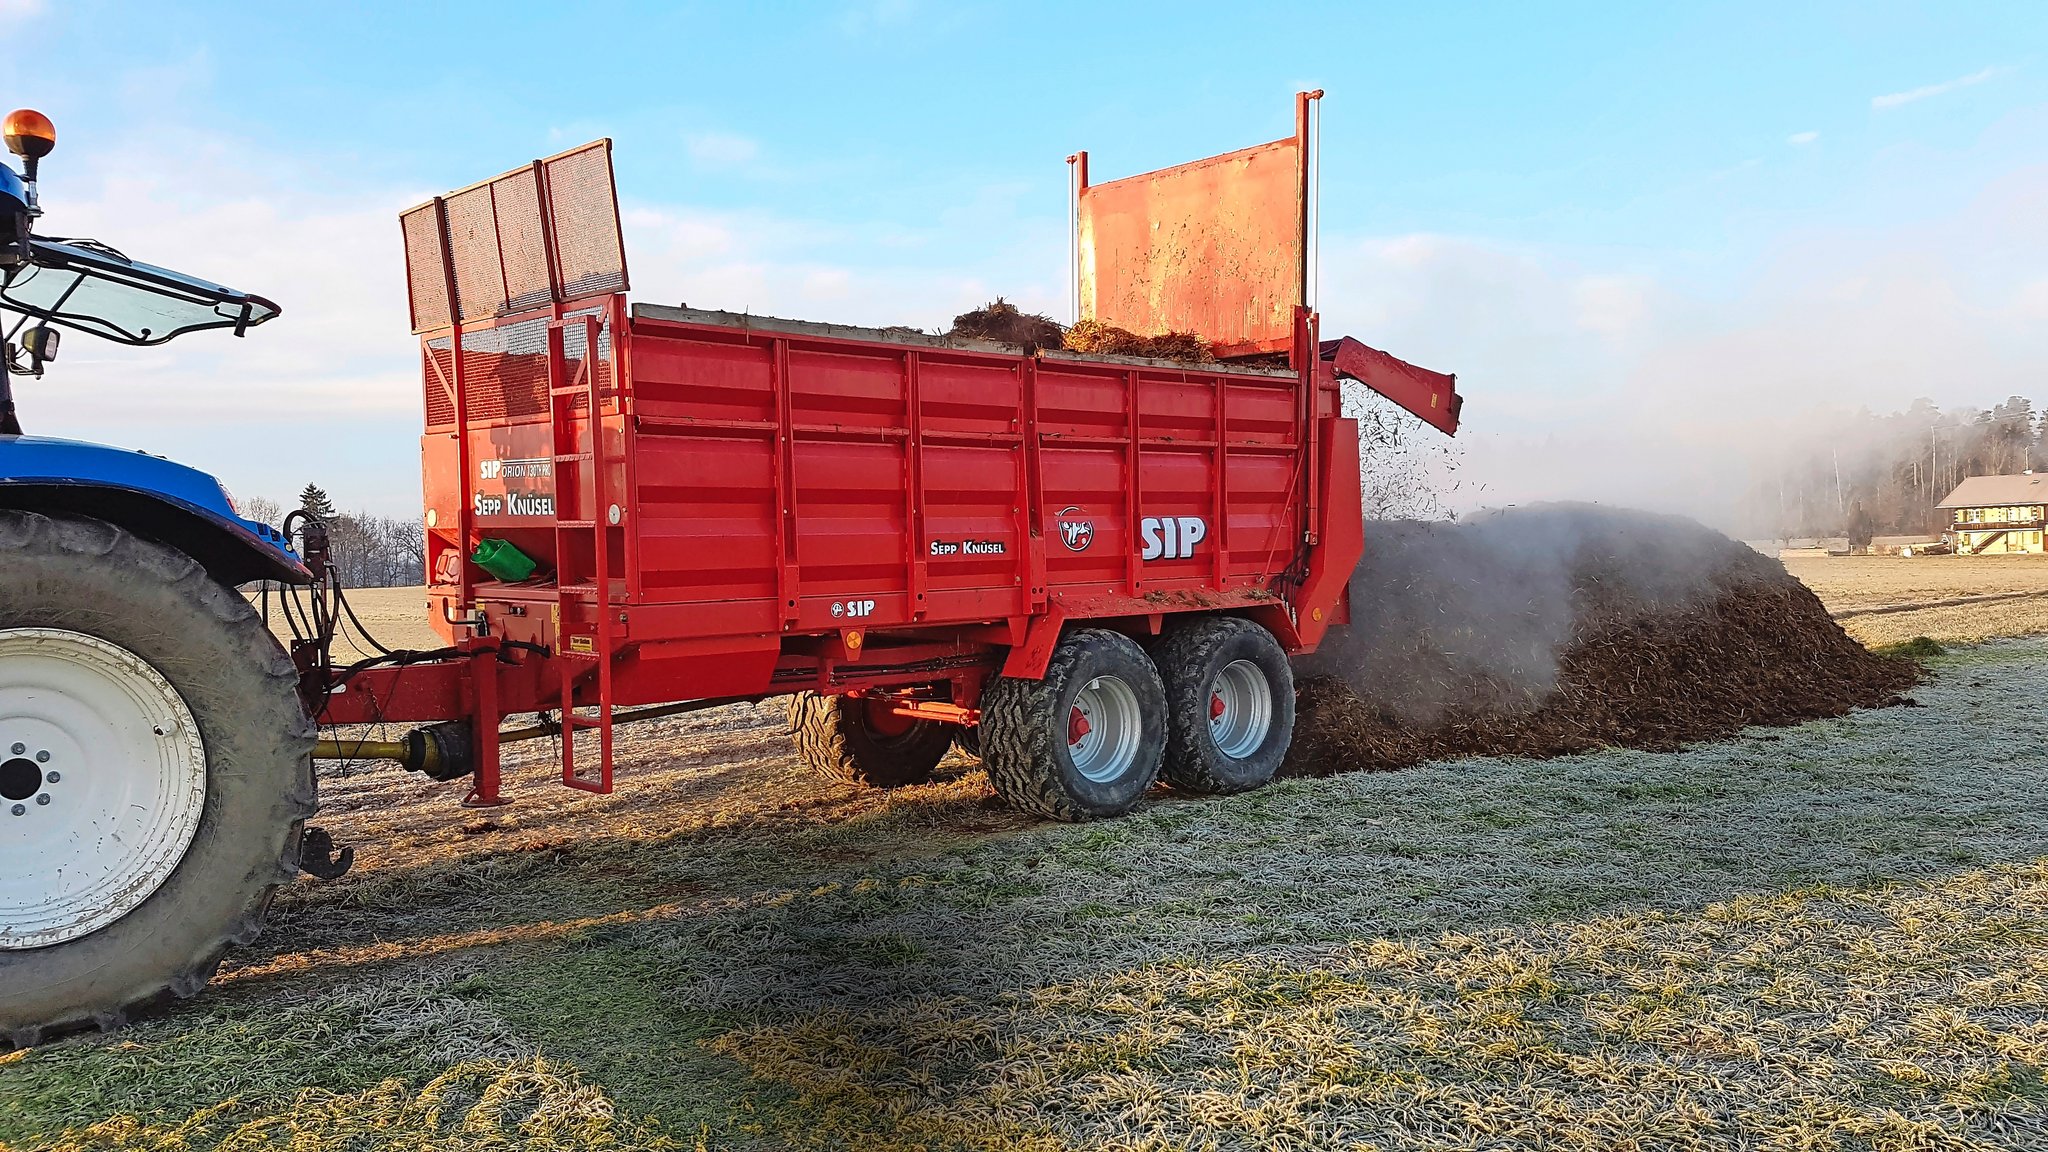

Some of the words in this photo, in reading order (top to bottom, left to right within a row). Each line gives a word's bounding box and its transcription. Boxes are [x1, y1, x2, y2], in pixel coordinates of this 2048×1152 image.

[480, 460, 501, 479] SIP
[501, 465, 526, 478] ORION
[1141, 517, 1206, 560] SIP
[847, 600, 875, 617] SIP
